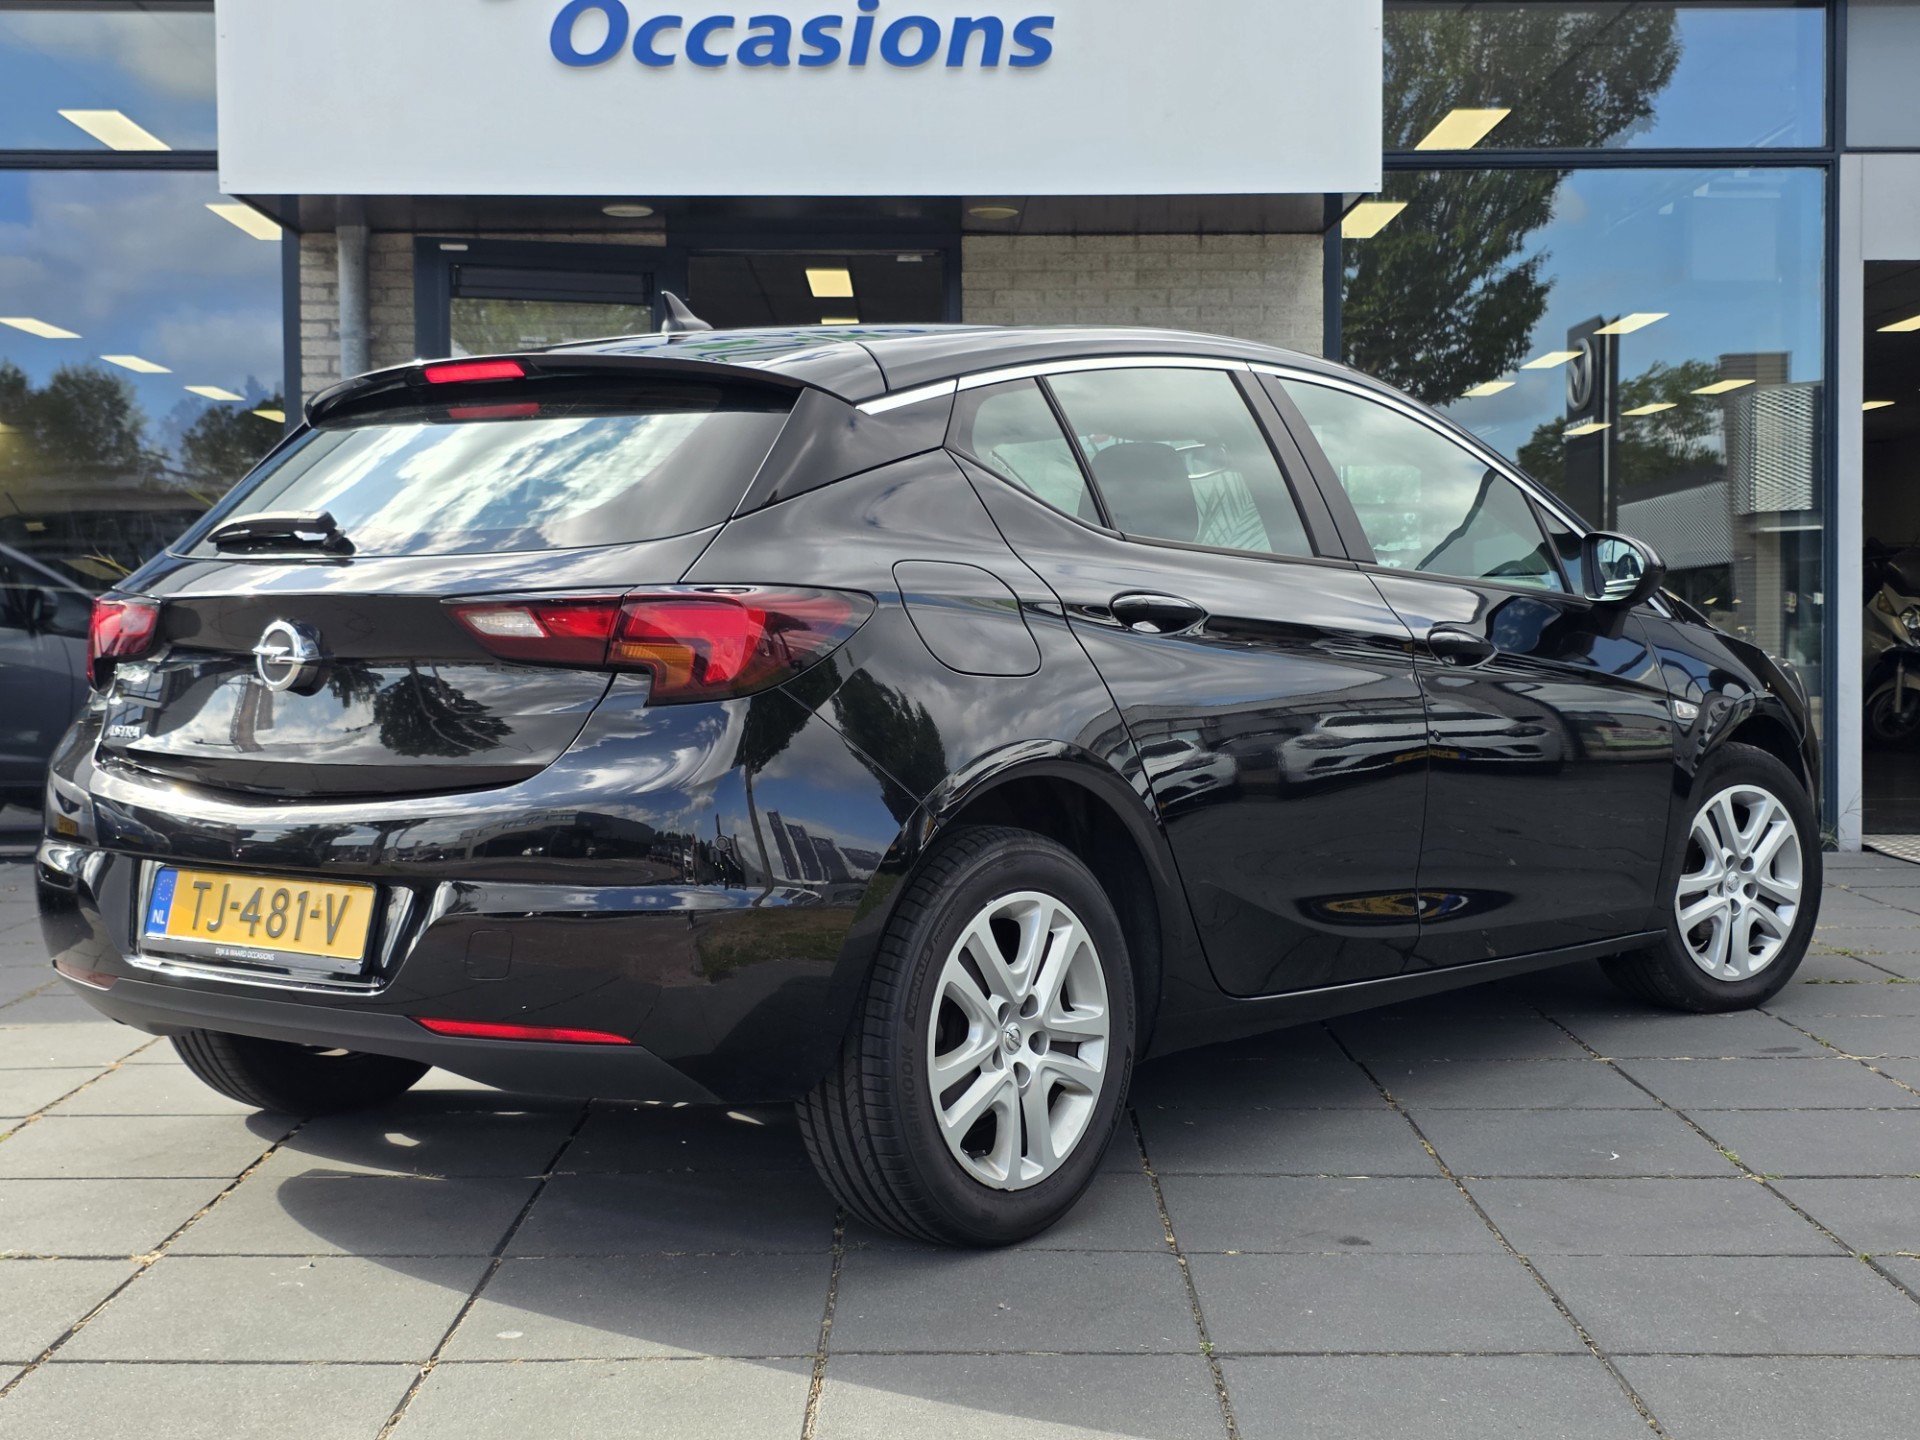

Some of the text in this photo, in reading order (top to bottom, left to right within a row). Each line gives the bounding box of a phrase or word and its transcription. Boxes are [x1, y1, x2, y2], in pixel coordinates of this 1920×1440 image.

[550, 0, 1055, 67] Occasions
[152, 909, 166, 924] NL
[193, 881, 350, 945] TJ-481-V
[247, 951, 275, 961] OCCASIONS
